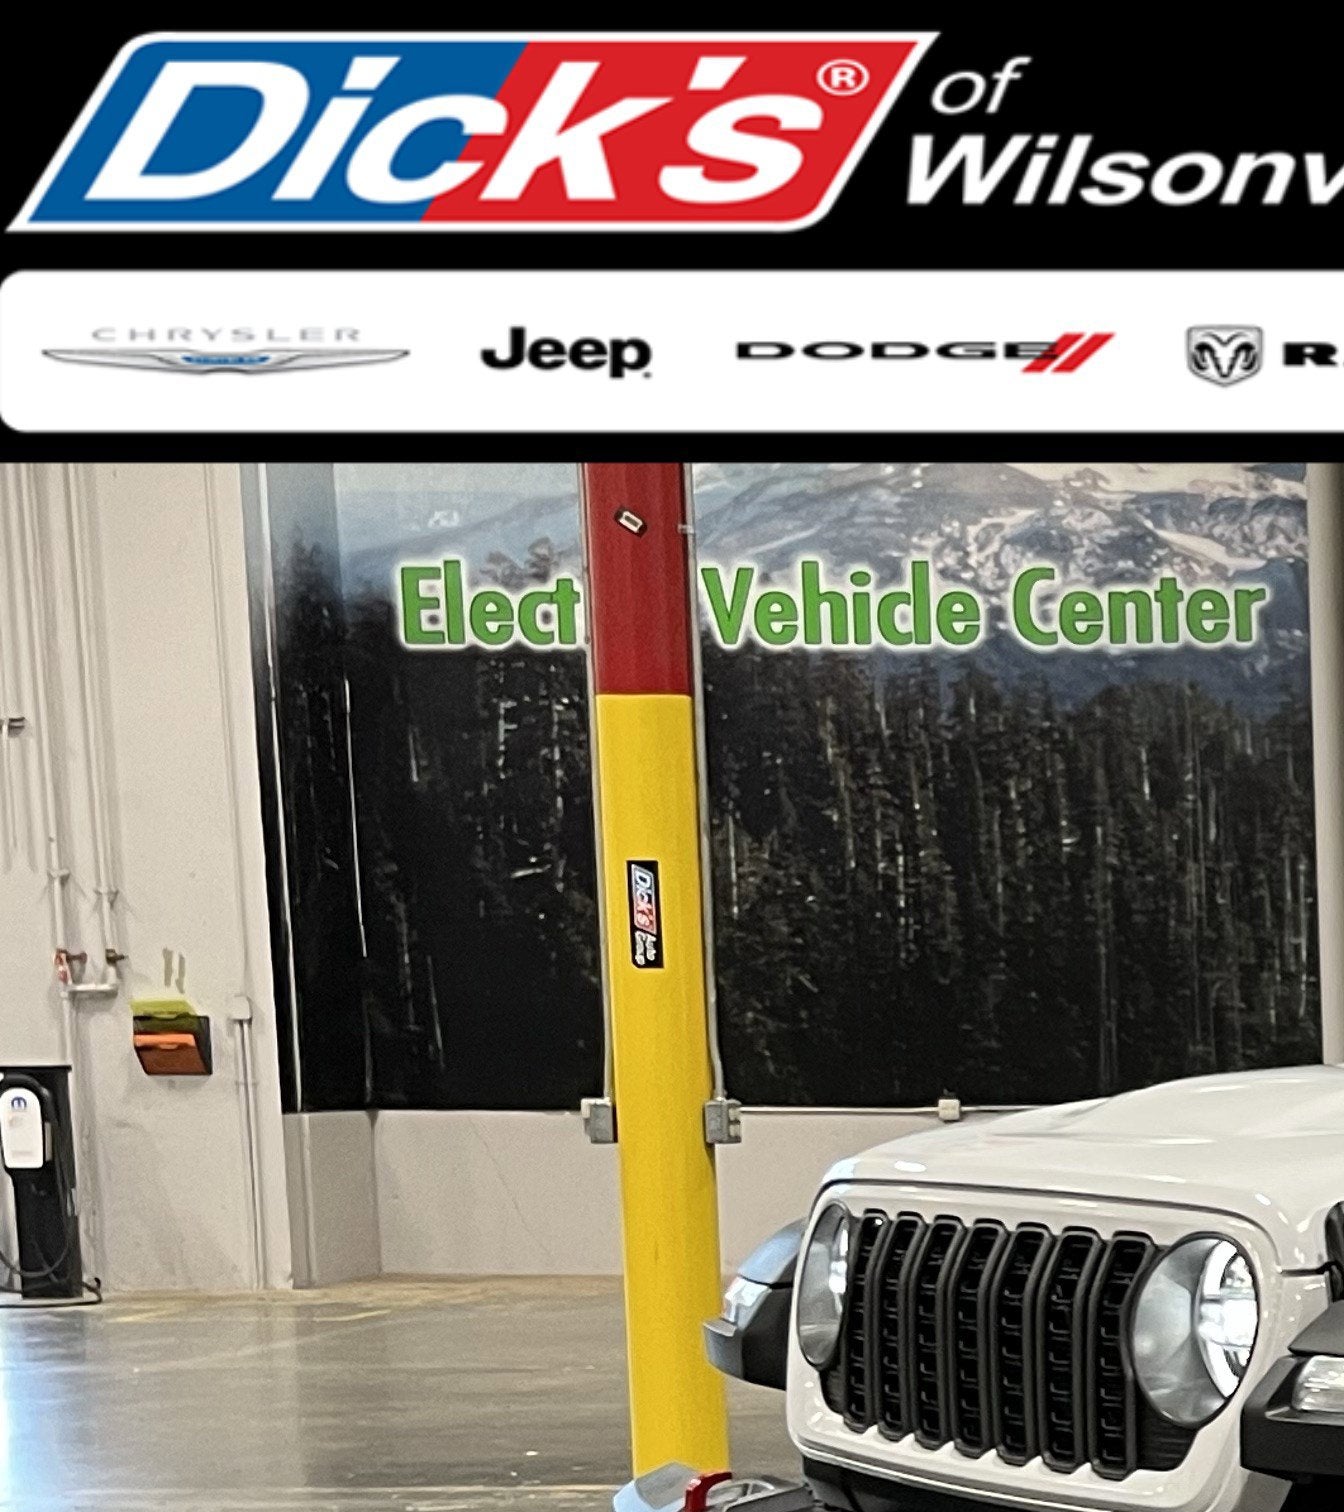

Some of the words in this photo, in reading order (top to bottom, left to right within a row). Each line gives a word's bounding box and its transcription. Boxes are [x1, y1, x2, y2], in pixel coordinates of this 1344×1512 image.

[401, 559, 581, 646] Elect
[701, 560, 981, 646] Vehicle
[1012, 566, 1267, 646] Center
